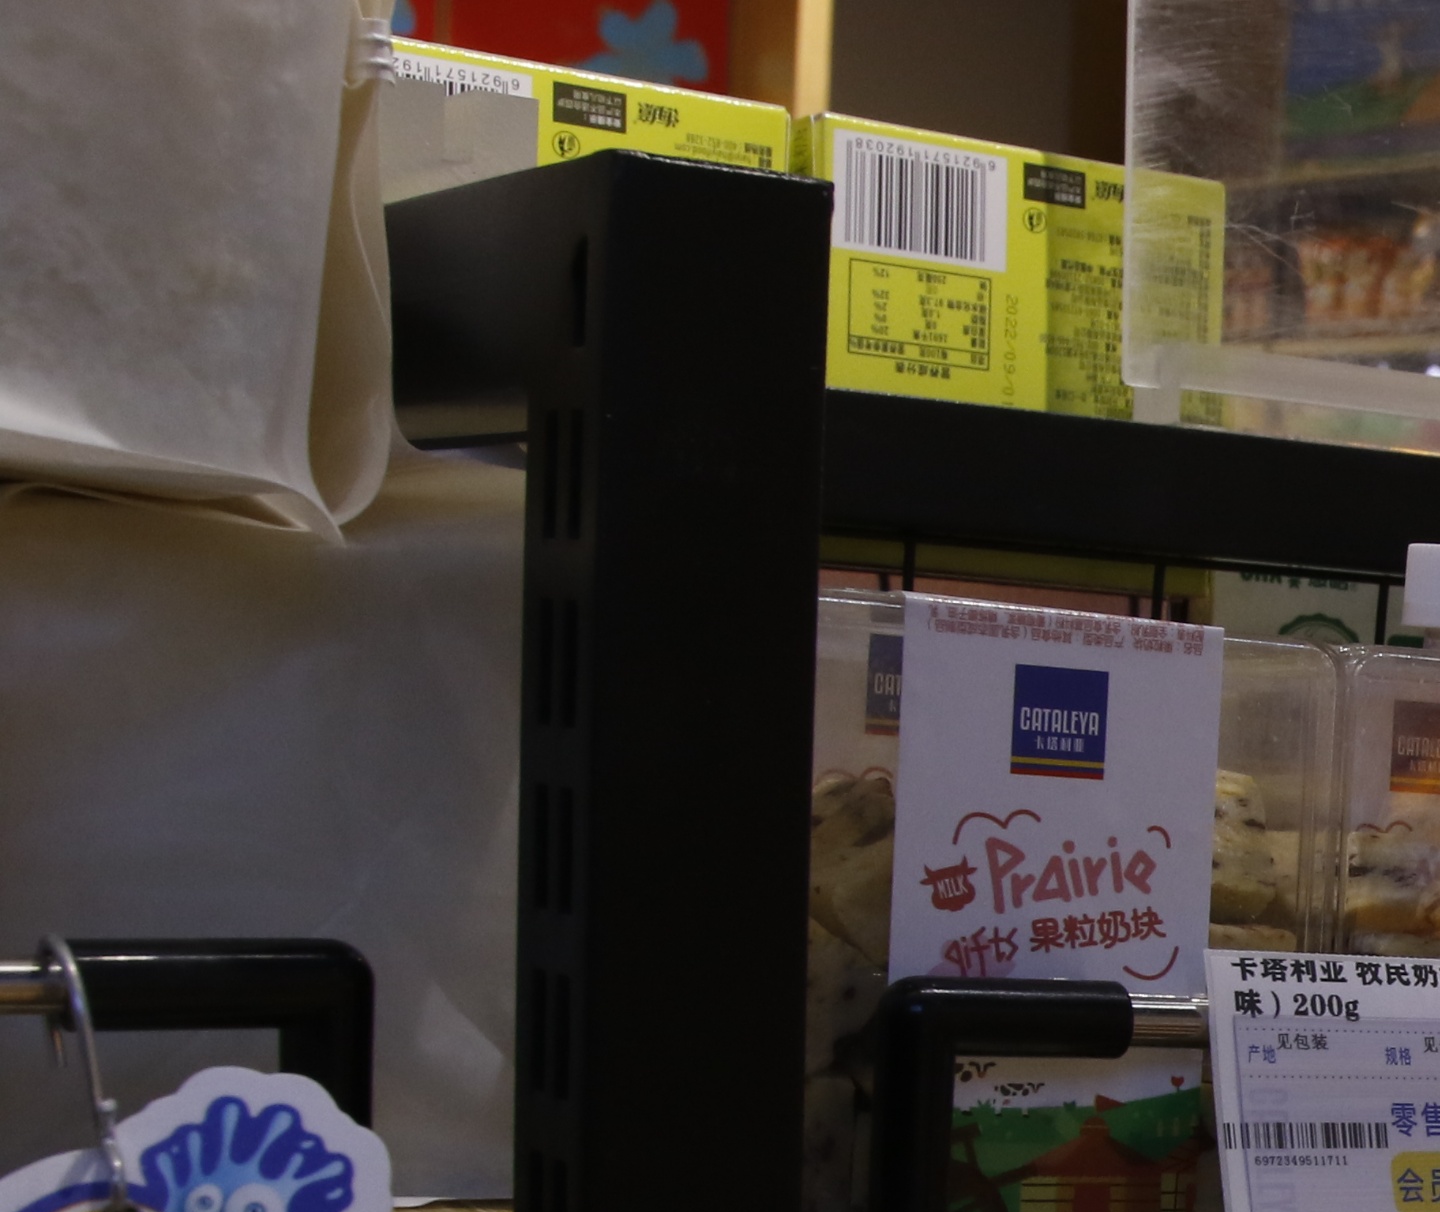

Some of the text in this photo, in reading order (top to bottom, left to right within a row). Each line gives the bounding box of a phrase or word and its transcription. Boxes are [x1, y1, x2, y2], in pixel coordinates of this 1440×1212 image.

[1018, 705, 1100, 738] CATALEYA
[935, 866, 969, 901] MILK
[984, 836, 1160, 915] Prairie
[1029, 906, 1167, 954] 果粒奶块
[942, 927, 1020, 978] gifts
[1234, 990, 1360, 1021] 味）200g
[1247, 1033, 1329, 1065] 产地 见包装
[1384, 1046, 1412, 1067] 规格
